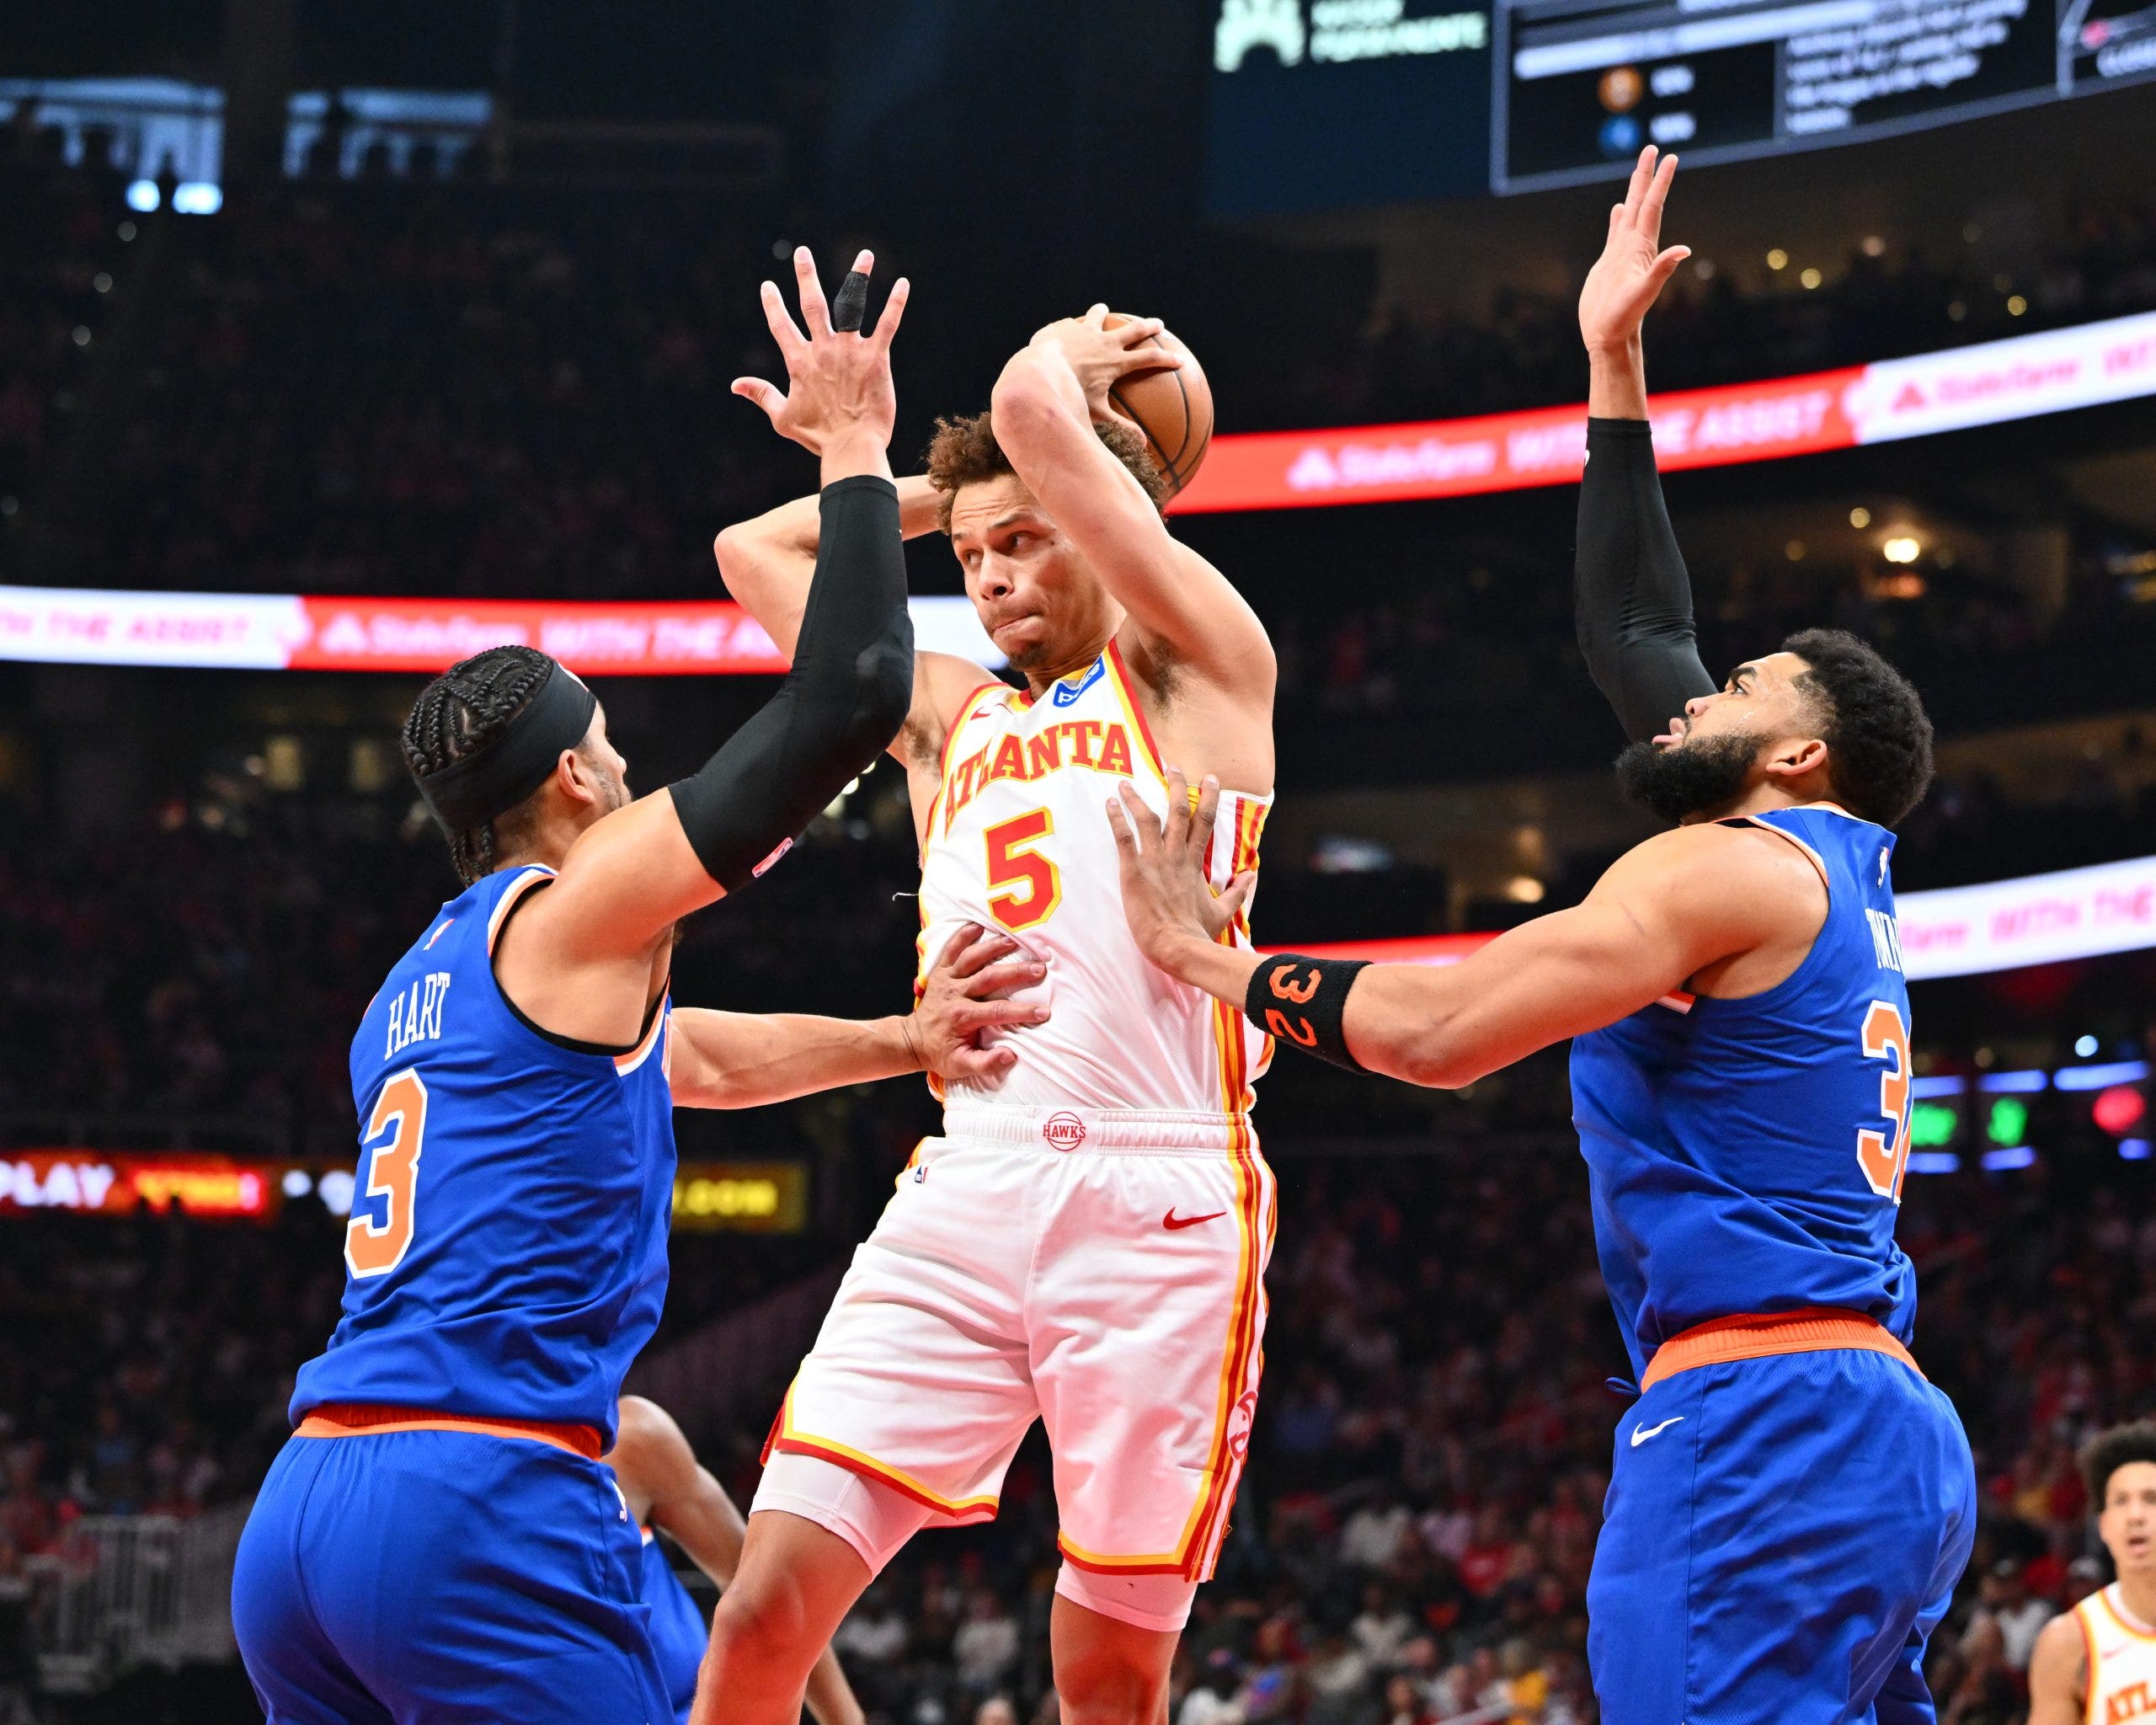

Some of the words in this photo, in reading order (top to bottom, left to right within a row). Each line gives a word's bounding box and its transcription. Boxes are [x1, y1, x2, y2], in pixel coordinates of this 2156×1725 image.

[943, 719, 1135, 842] ATLANTA
[983, 805, 1062, 933] 5
[384, 971, 451, 1061] HART
[1265, 963, 1322, 1048] 32
[1043, 1124, 1086, 1139] HAWKS
[1855, 1000, 1913, 1207] 3
[344, 1066, 428, 1279] 3
